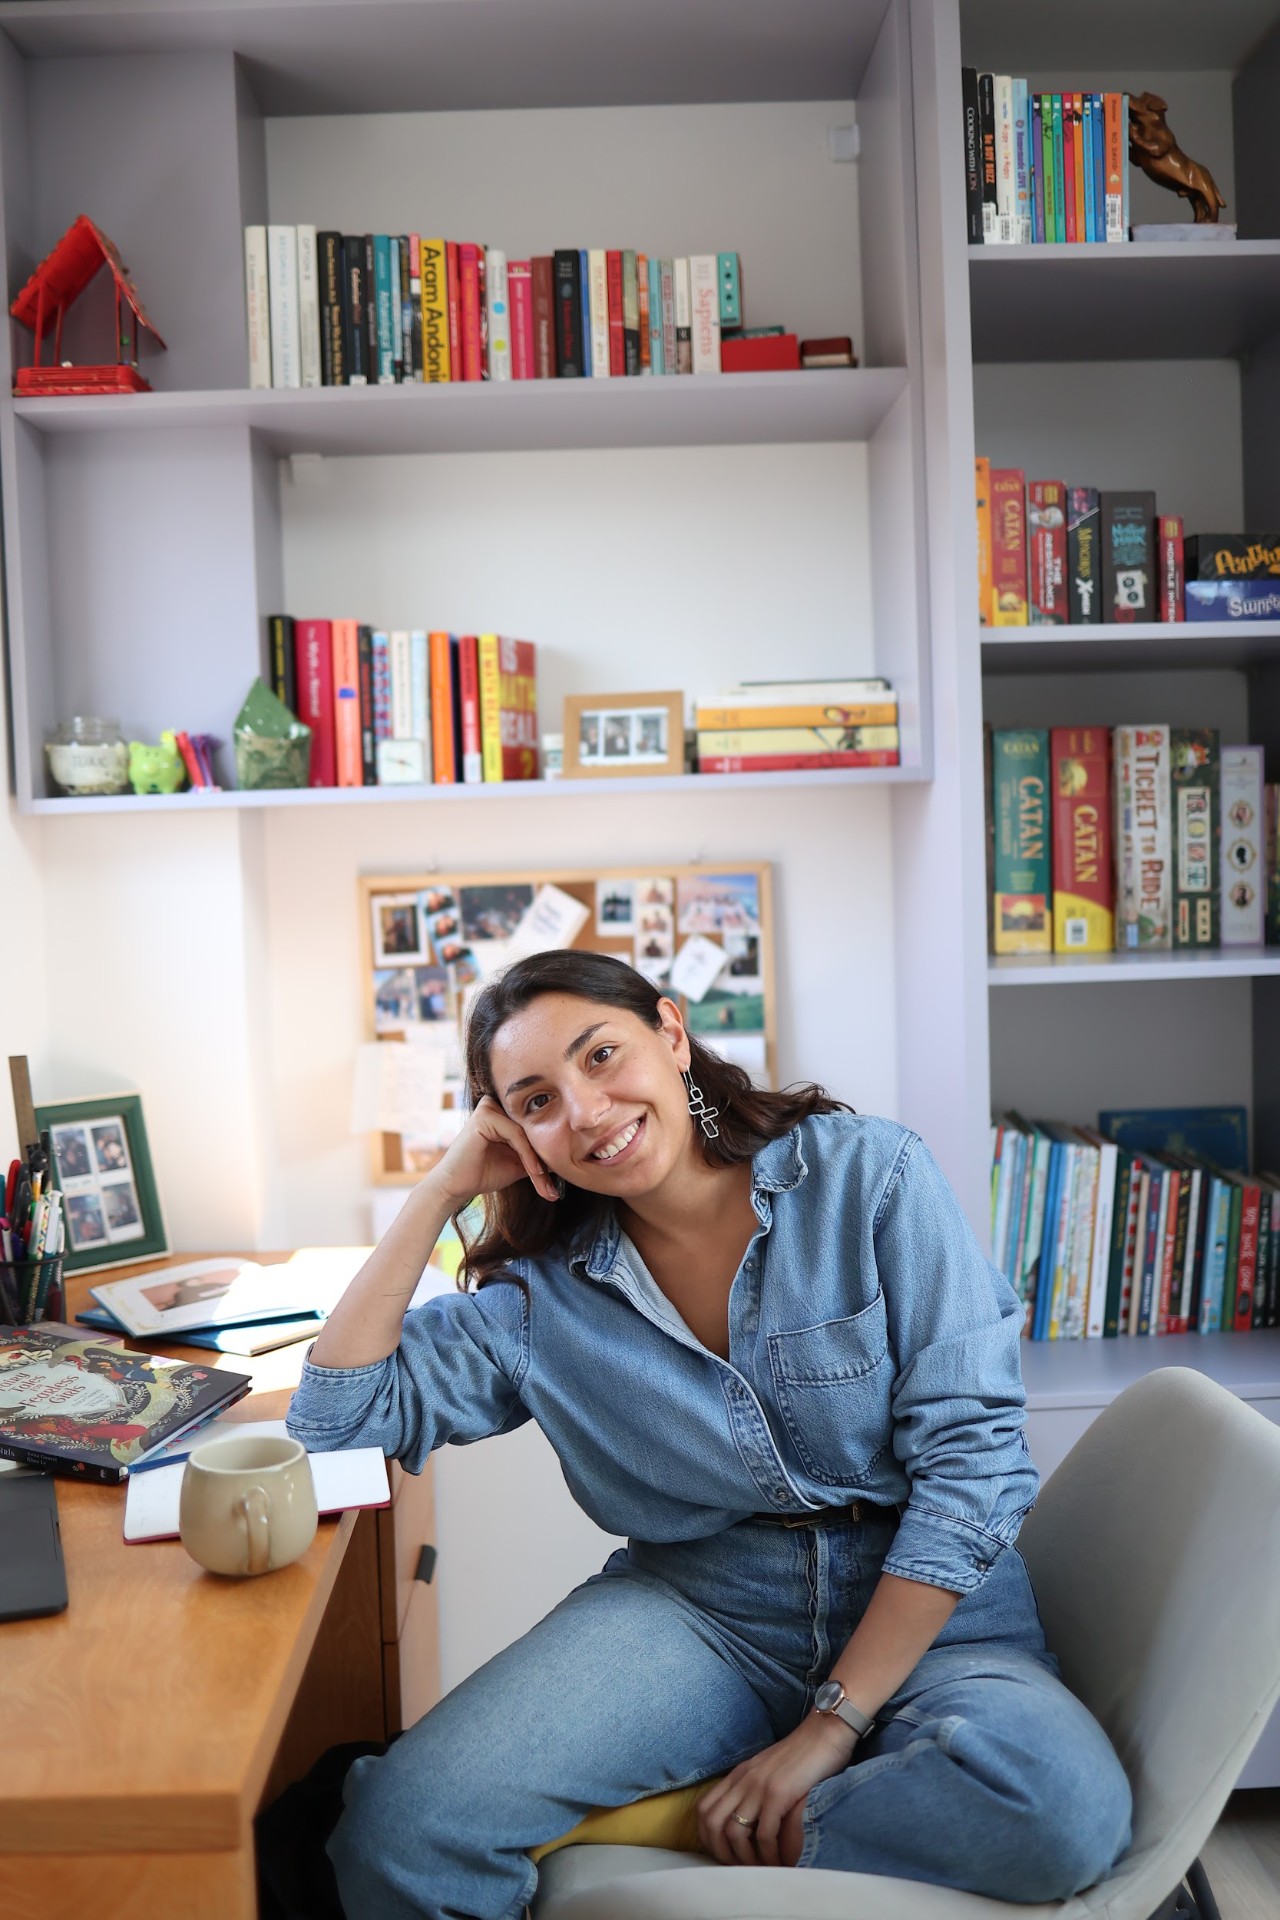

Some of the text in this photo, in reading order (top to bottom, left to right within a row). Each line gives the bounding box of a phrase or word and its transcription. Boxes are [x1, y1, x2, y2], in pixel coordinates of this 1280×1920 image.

[967, 107, 976, 149] COOKING
[968, 149, 977, 172] WITH
[985, 163, 995, 184] BUZZ
[424, 246, 441, 303] Aram
[695, 287, 715, 356] Sapiens
[1004, 500, 1020, 550] CATAN
[1044, 532, 1056, 609] RESISTANCE
[1054, 557, 1062, 585] THE
[1167, 541, 1176, 623] HOSTILE INTEN
[1019, 776, 1044, 860] CATAN
[1074, 804, 1098, 882] CATAN
[1136, 752, 1164, 909] TICKET TO RIDE
[1186, 792, 1208, 887] ROOT
